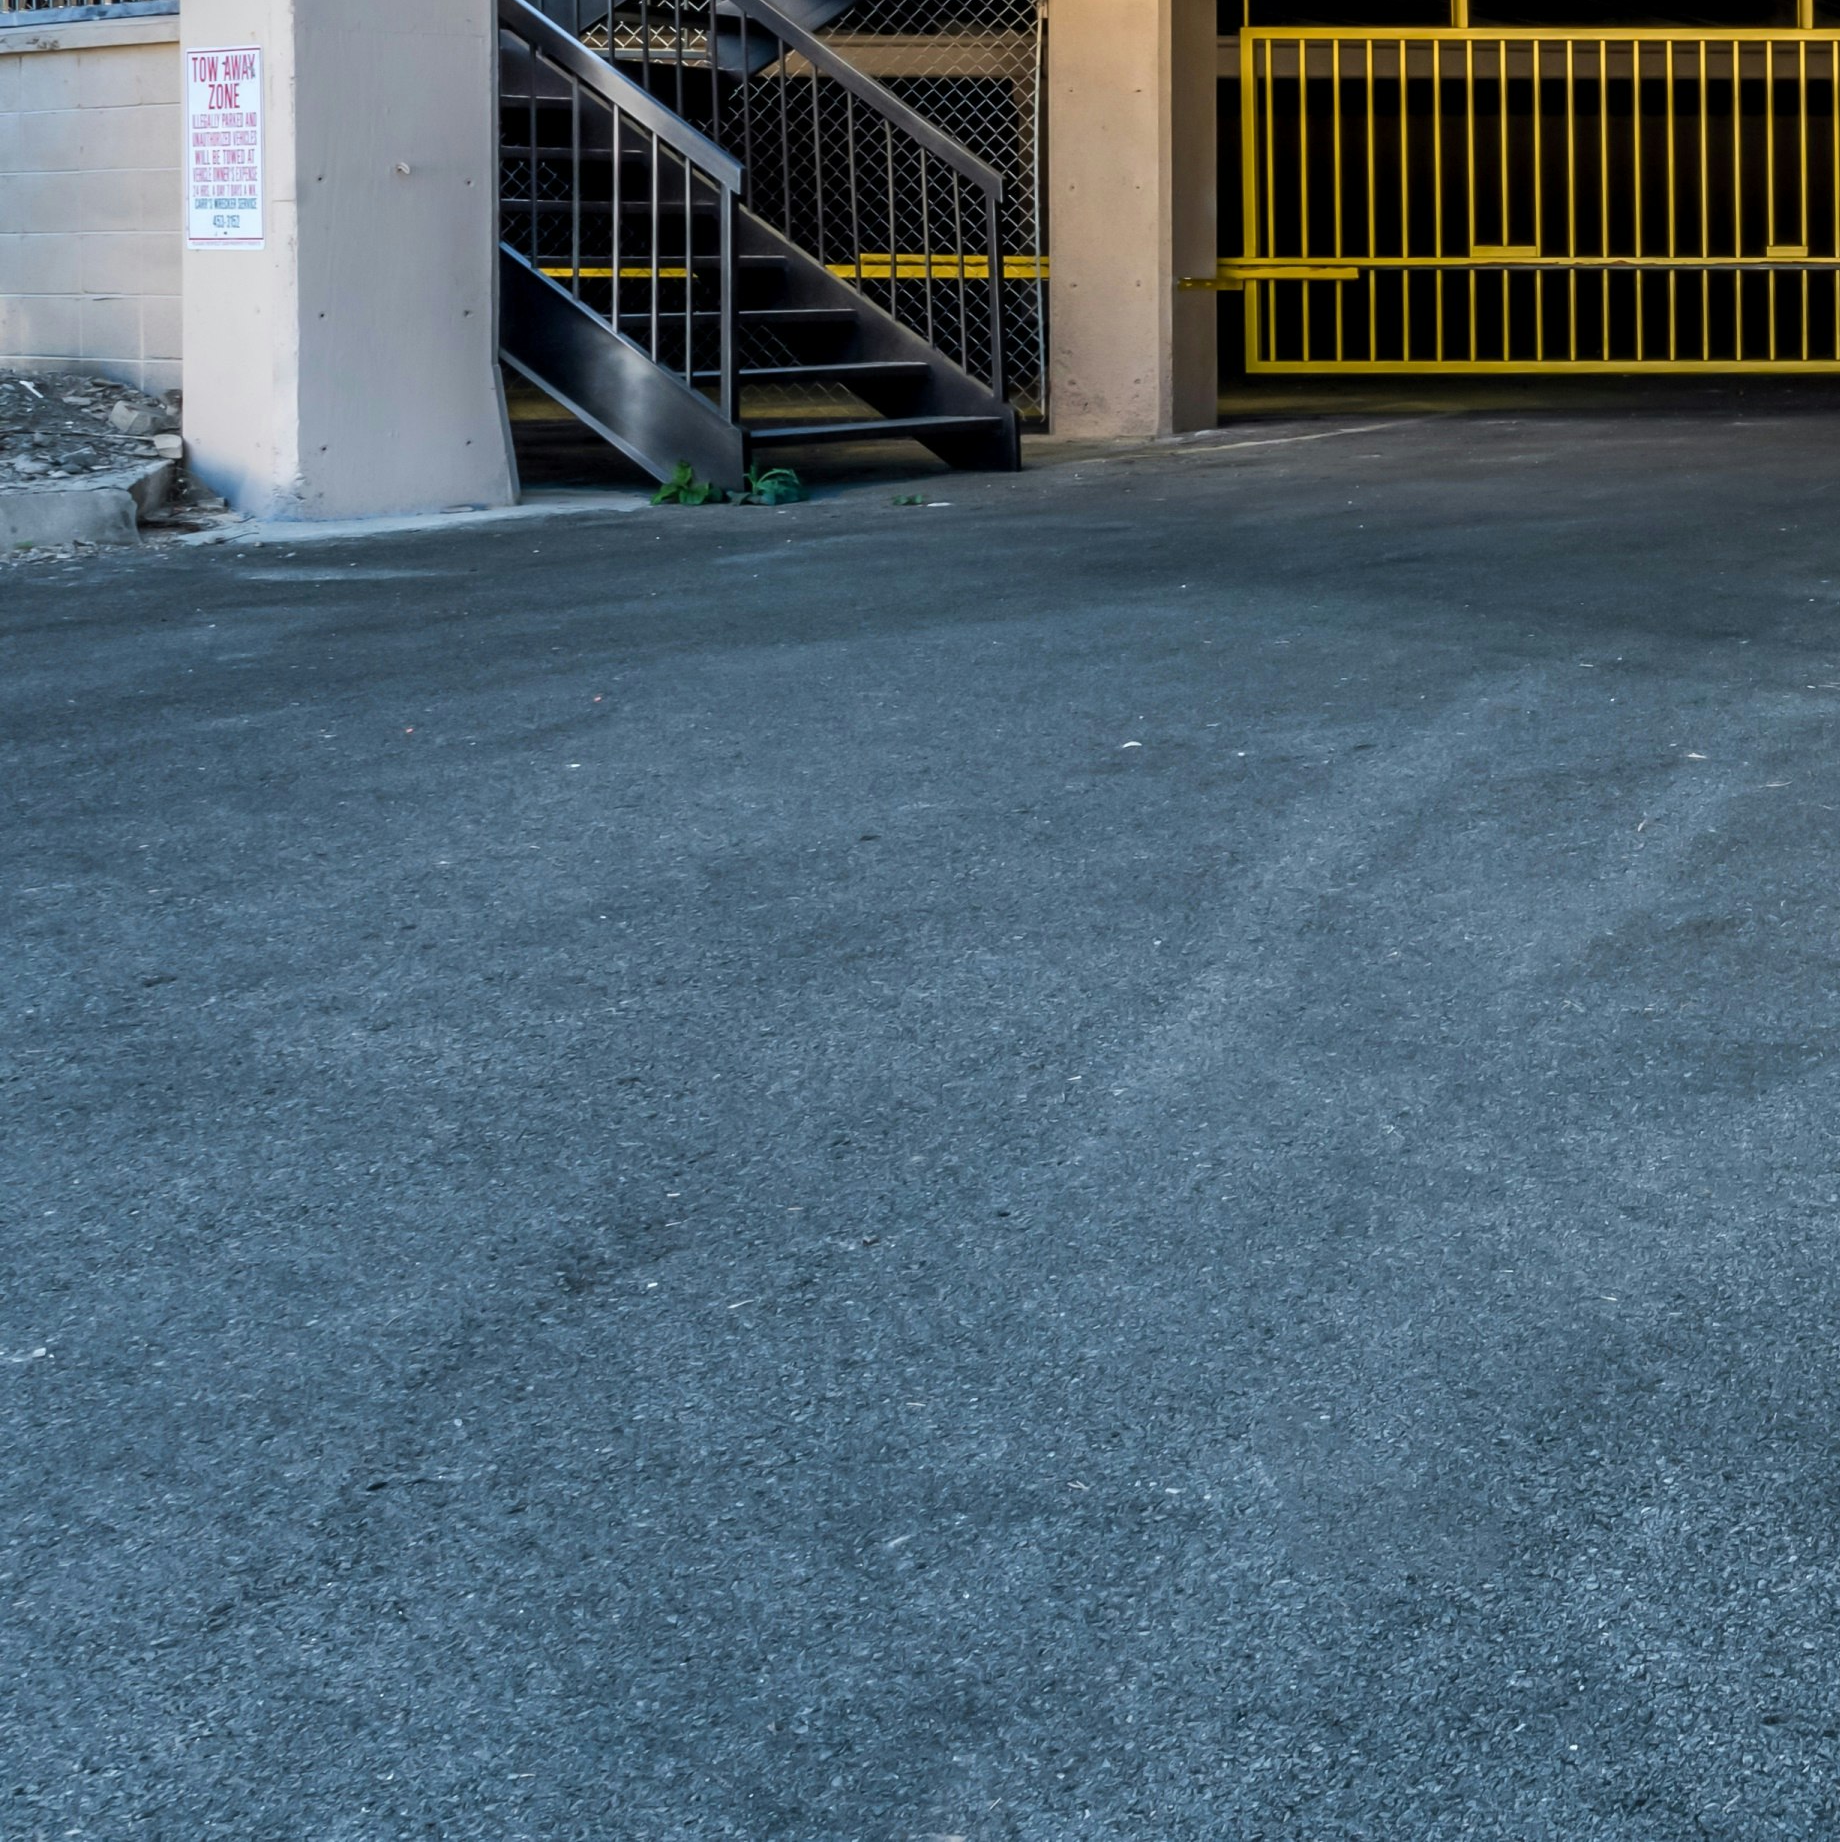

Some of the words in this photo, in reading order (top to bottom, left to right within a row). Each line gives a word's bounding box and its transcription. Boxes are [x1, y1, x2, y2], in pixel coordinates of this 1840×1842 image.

[192, 55, 218, 83] TOW
[223, 54, 256, 81] AWAY
[208, 83, 240, 110] ZONE
[212, 149, 221, 165] BE
[247, 148, 255, 164] AT
